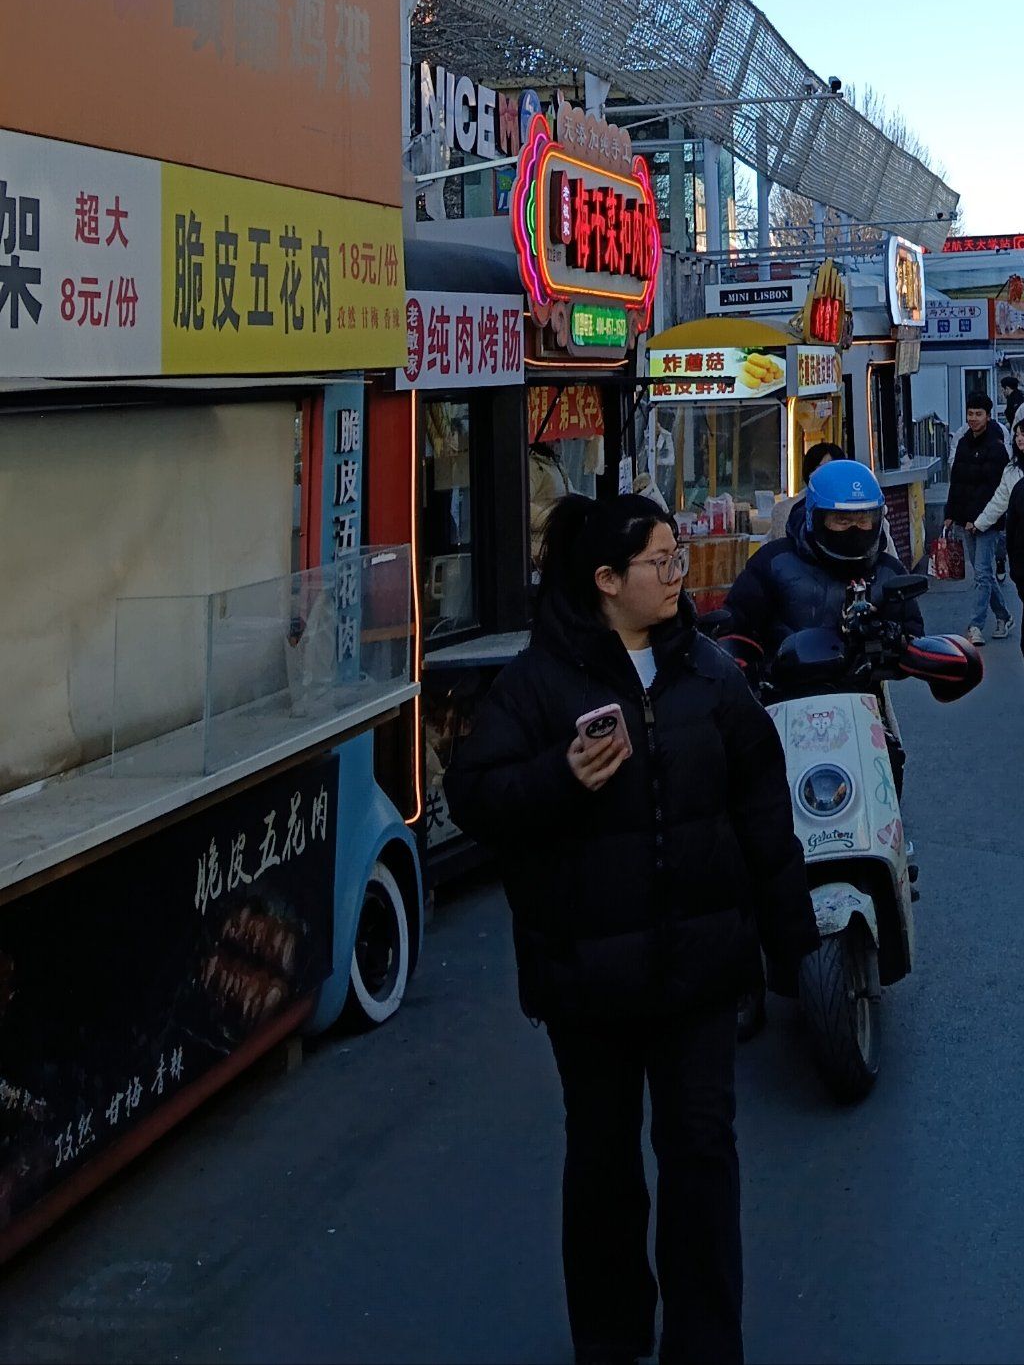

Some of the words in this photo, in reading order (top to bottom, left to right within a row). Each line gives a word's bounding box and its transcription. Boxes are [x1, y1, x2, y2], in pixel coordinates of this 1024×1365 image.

[419, 61, 497, 159] NICE
[74, 190, 130, 250] 超大
[172, 210, 332, 336] 脆皮五花肉
[337, 241, 399, 288] 18元/份
[754, 289, 789, 301] LISBON
[60, 274, 139, 329] 8元/份
[427, 304, 522, 379] 纯肉烤肠
[662, 351, 725, 374] 炸蘑菇
[332, 408, 362, 662] 脆皮五花肉
[194, 782, 330, 914] 脆皮五花肉
